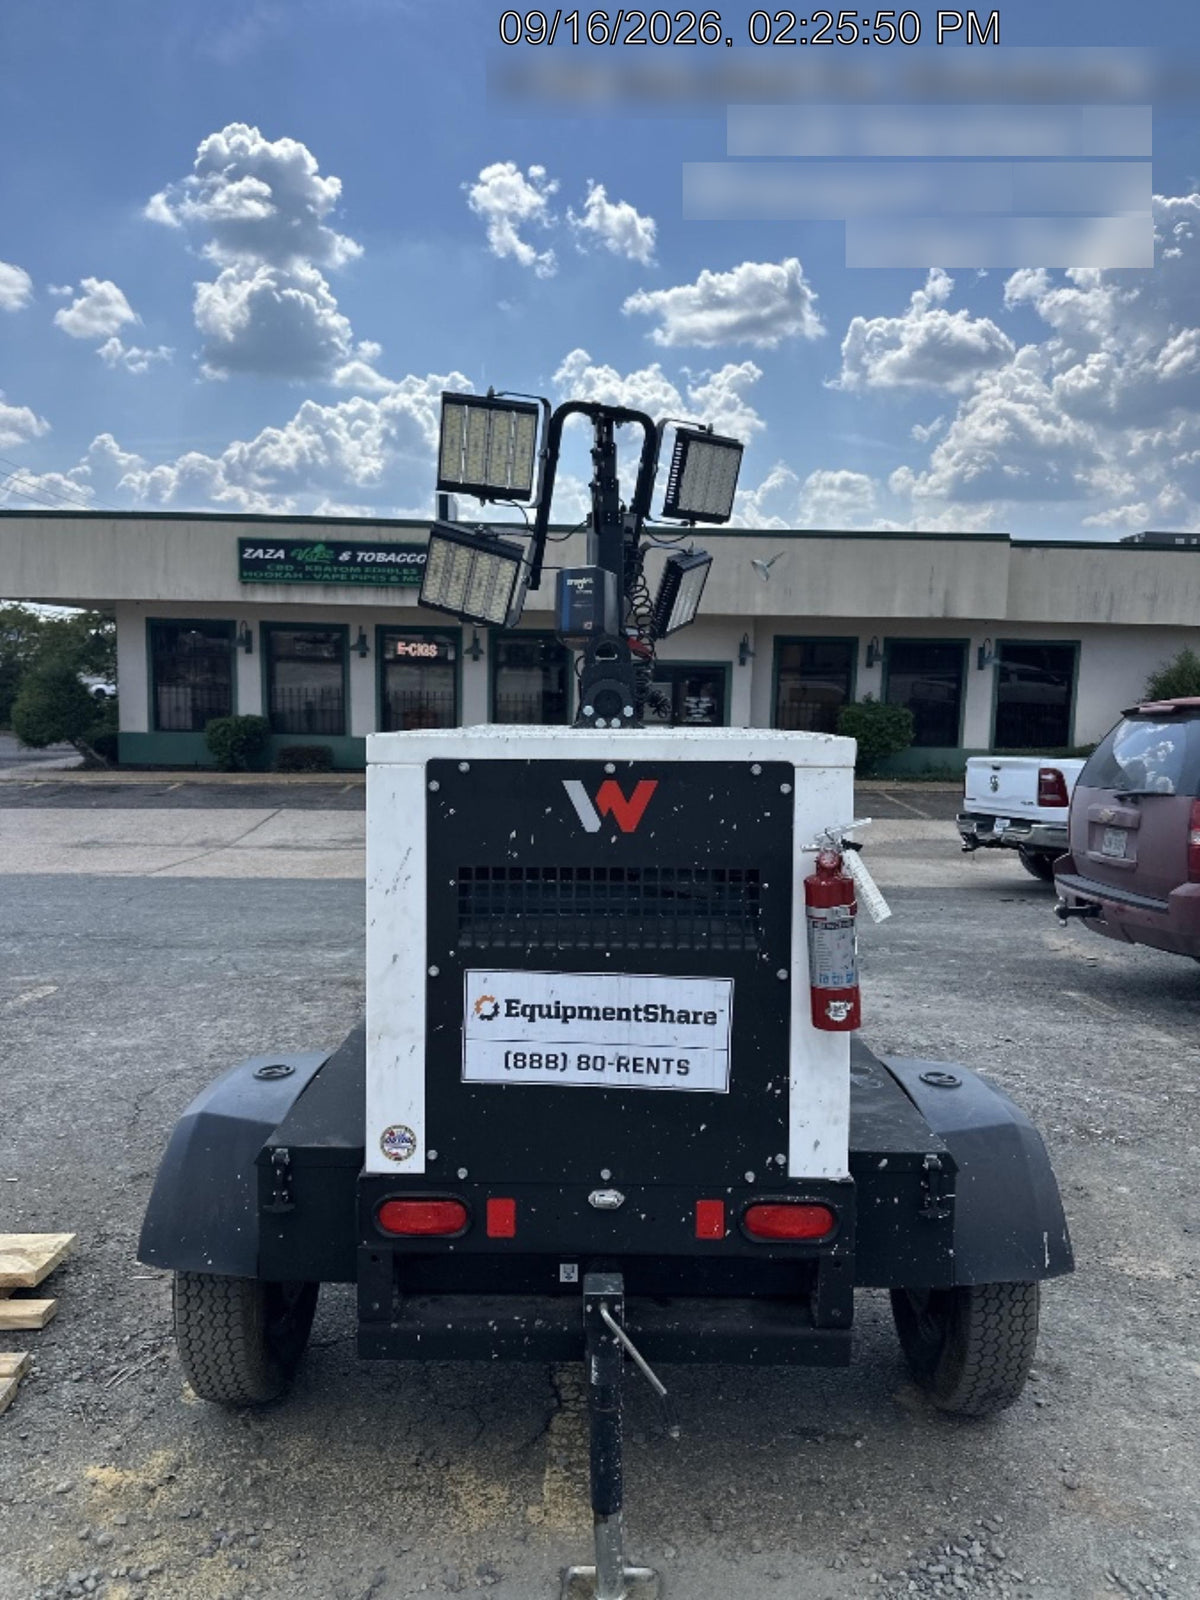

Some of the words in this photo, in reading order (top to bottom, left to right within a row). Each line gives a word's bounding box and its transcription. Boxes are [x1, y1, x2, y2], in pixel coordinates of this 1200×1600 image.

[242, 548, 285, 559] ZAZA
[339, 551, 352, 562] &
[356, 552, 427, 564] TOBACCO
[396, 641, 438, 658] E-CIGS
[504, 999, 718, 1026] EquipmentShare
[504, 1050, 568, 1073] (888)
[577, 1054, 691, 1077] 80-RENTS
